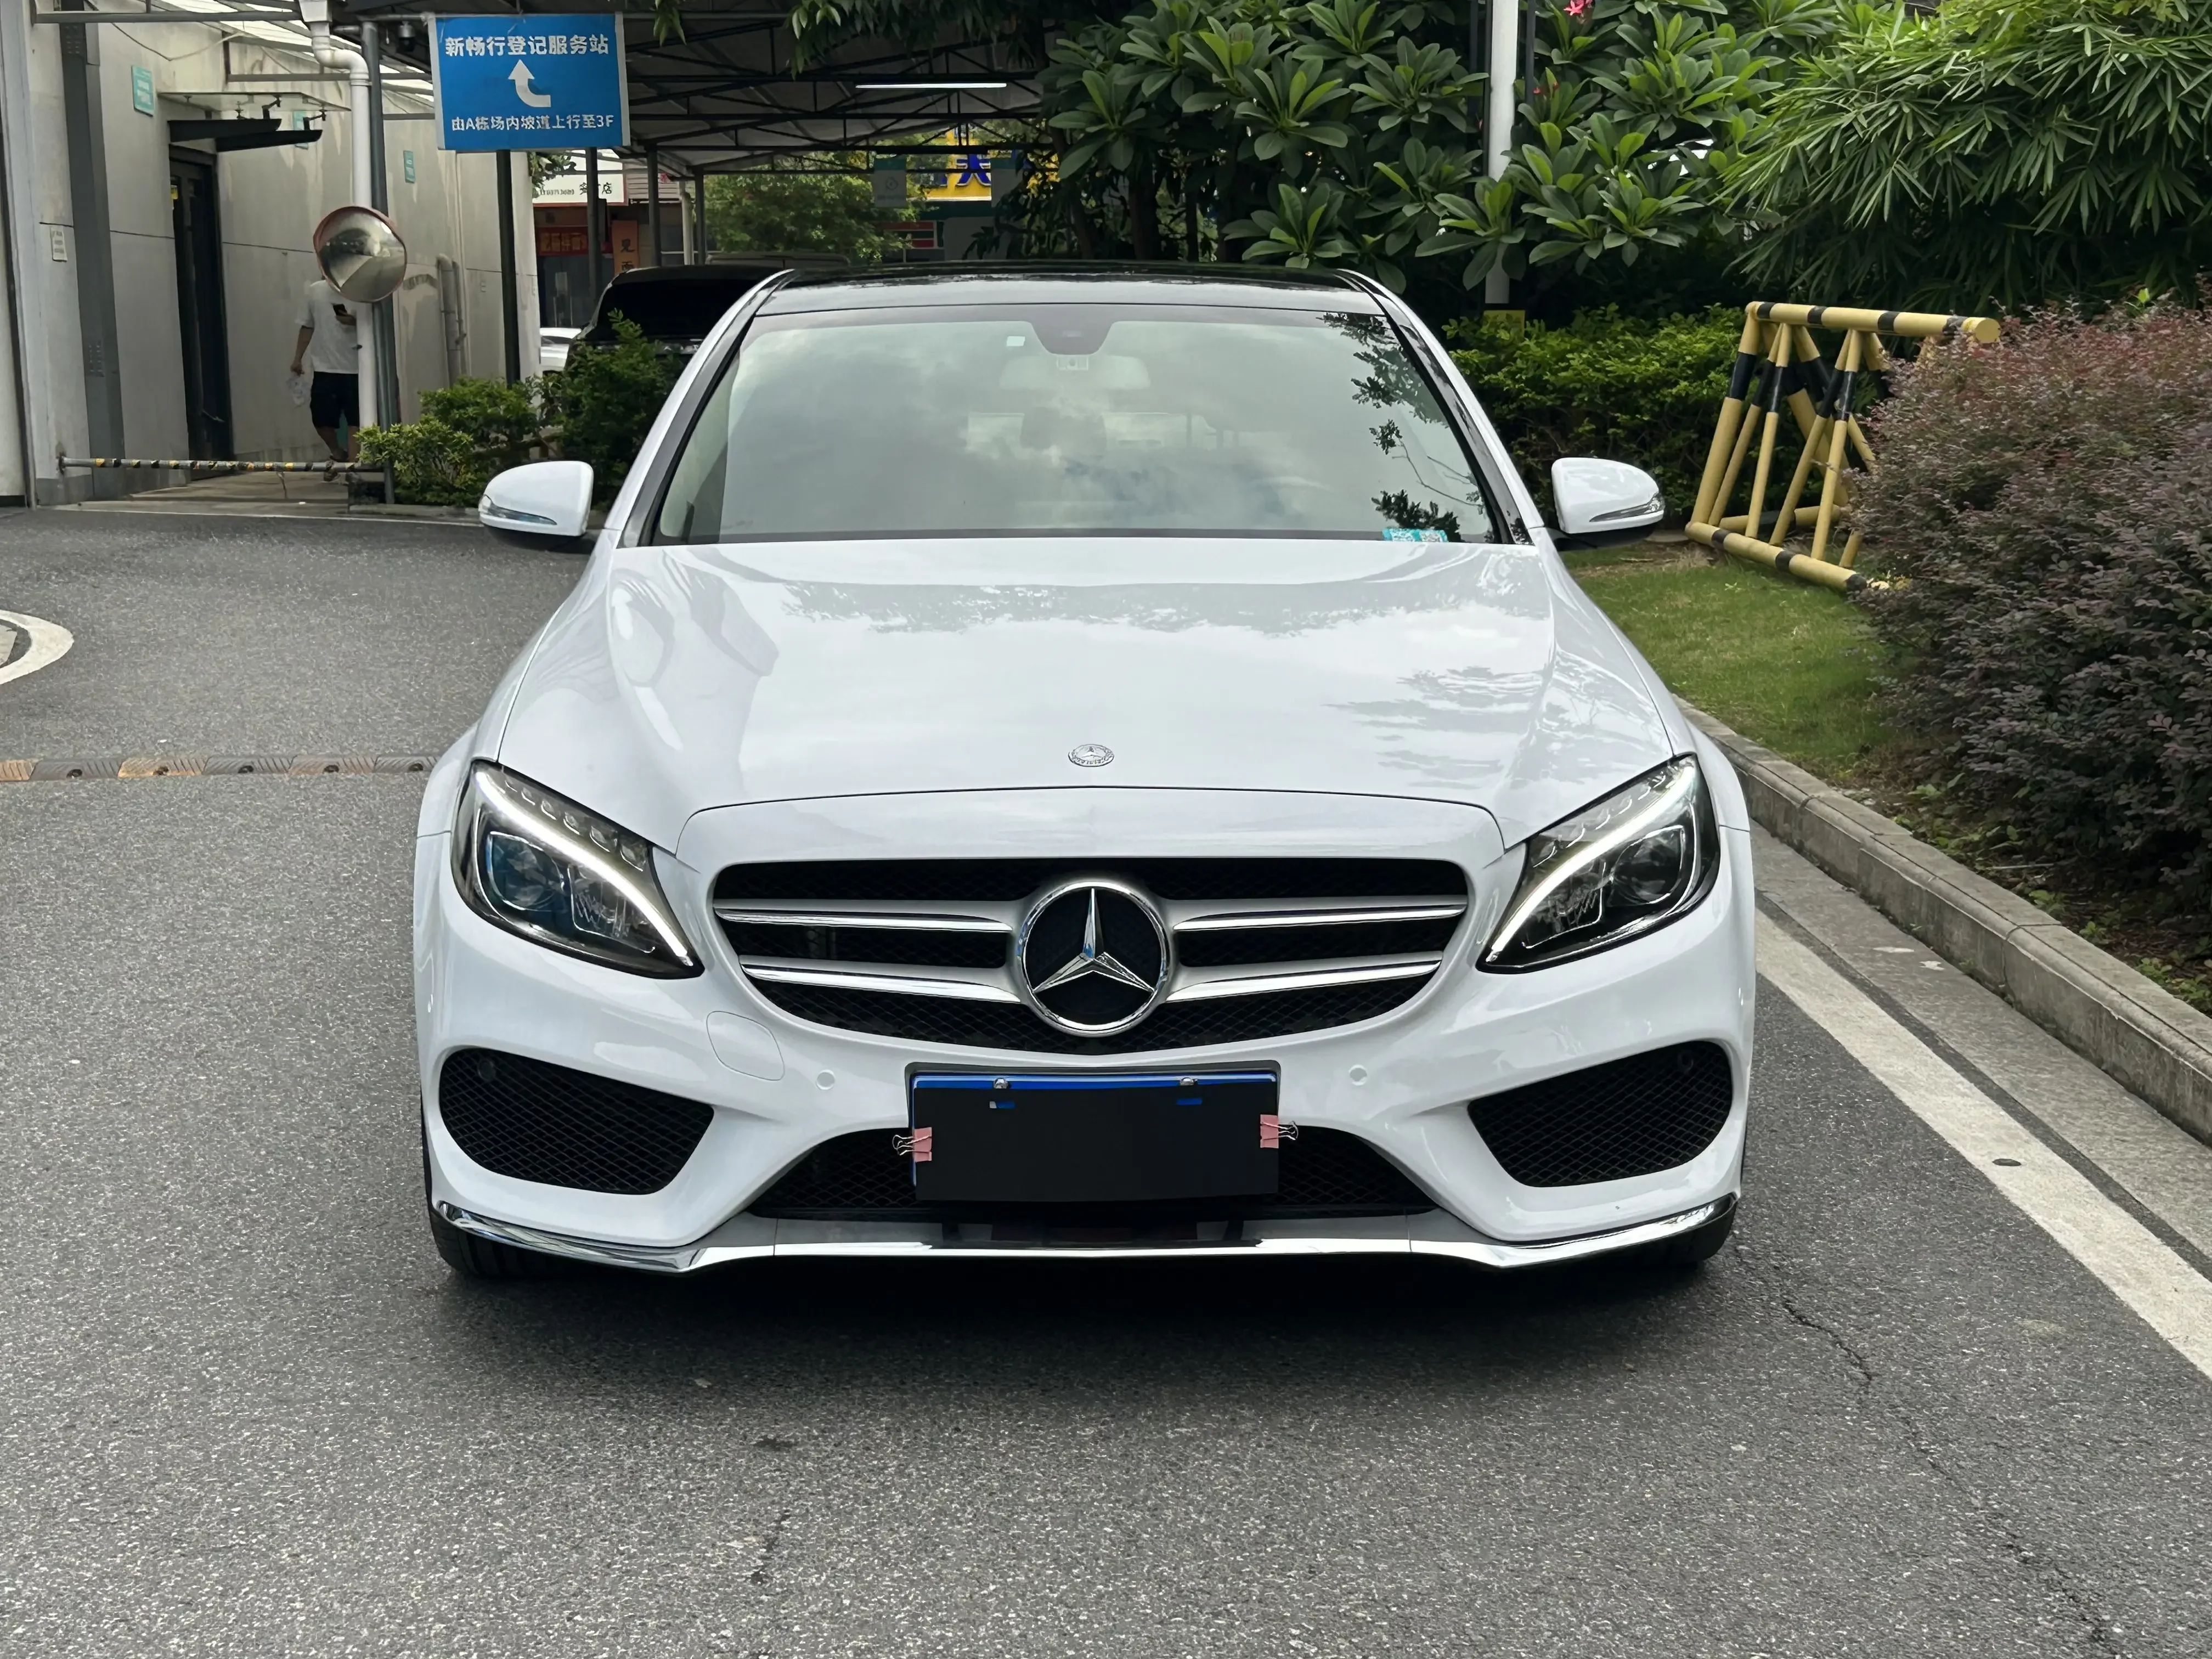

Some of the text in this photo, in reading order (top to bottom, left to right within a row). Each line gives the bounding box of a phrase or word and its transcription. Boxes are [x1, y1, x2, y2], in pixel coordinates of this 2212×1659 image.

[445, 34, 608, 57] 新畅行登记服务站
[452, 114, 614, 131] 由A栋场内坡道上行至3F
